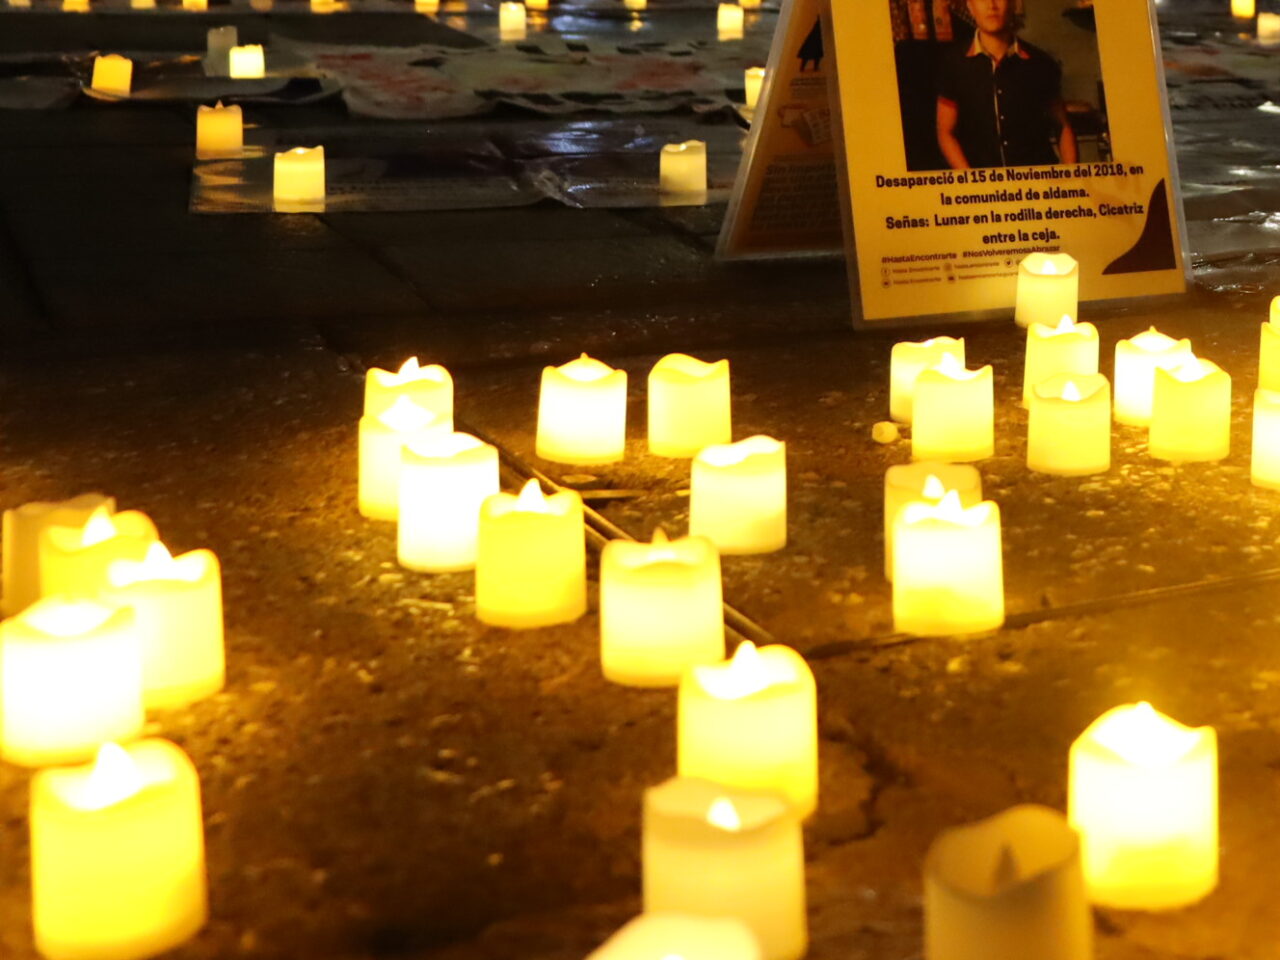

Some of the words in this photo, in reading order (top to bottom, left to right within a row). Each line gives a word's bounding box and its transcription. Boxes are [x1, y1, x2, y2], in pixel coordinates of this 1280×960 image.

[875, 171, 955, 189] Desapareció
[957, 170, 968, 183] el
[971, 170, 986, 183] 15
[989, 169, 1004, 181] de
[1006, 166, 1071, 180] Noviembre
[1074, 165, 1091, 178] del
[1094, 163, 1127, 177] 2018,
[1129, 165, 1144, 175] en
[940, 192, 952, 205] la
[955, 189, 1022, 205] comunidad
[1025, 188, 1040, 200] de
[1043, 186, 1090, 200] aldama.
[886, 215, 930, 230] Señas:
[934, 214, 970, 227] Lunar
[973, 214, 988, 225] en
[991, 210, 1001, 223] la
[1005, 208, 1042, 222] rodilla
[1045, 205, 1097, 220] derecha,
[1098, 202, 1144, 217] Cicatriz
[982, 230, 1016, 245] entre
[1018, 229, 1029, 242] la
[1032, 228, 1060, 243] ceja.
